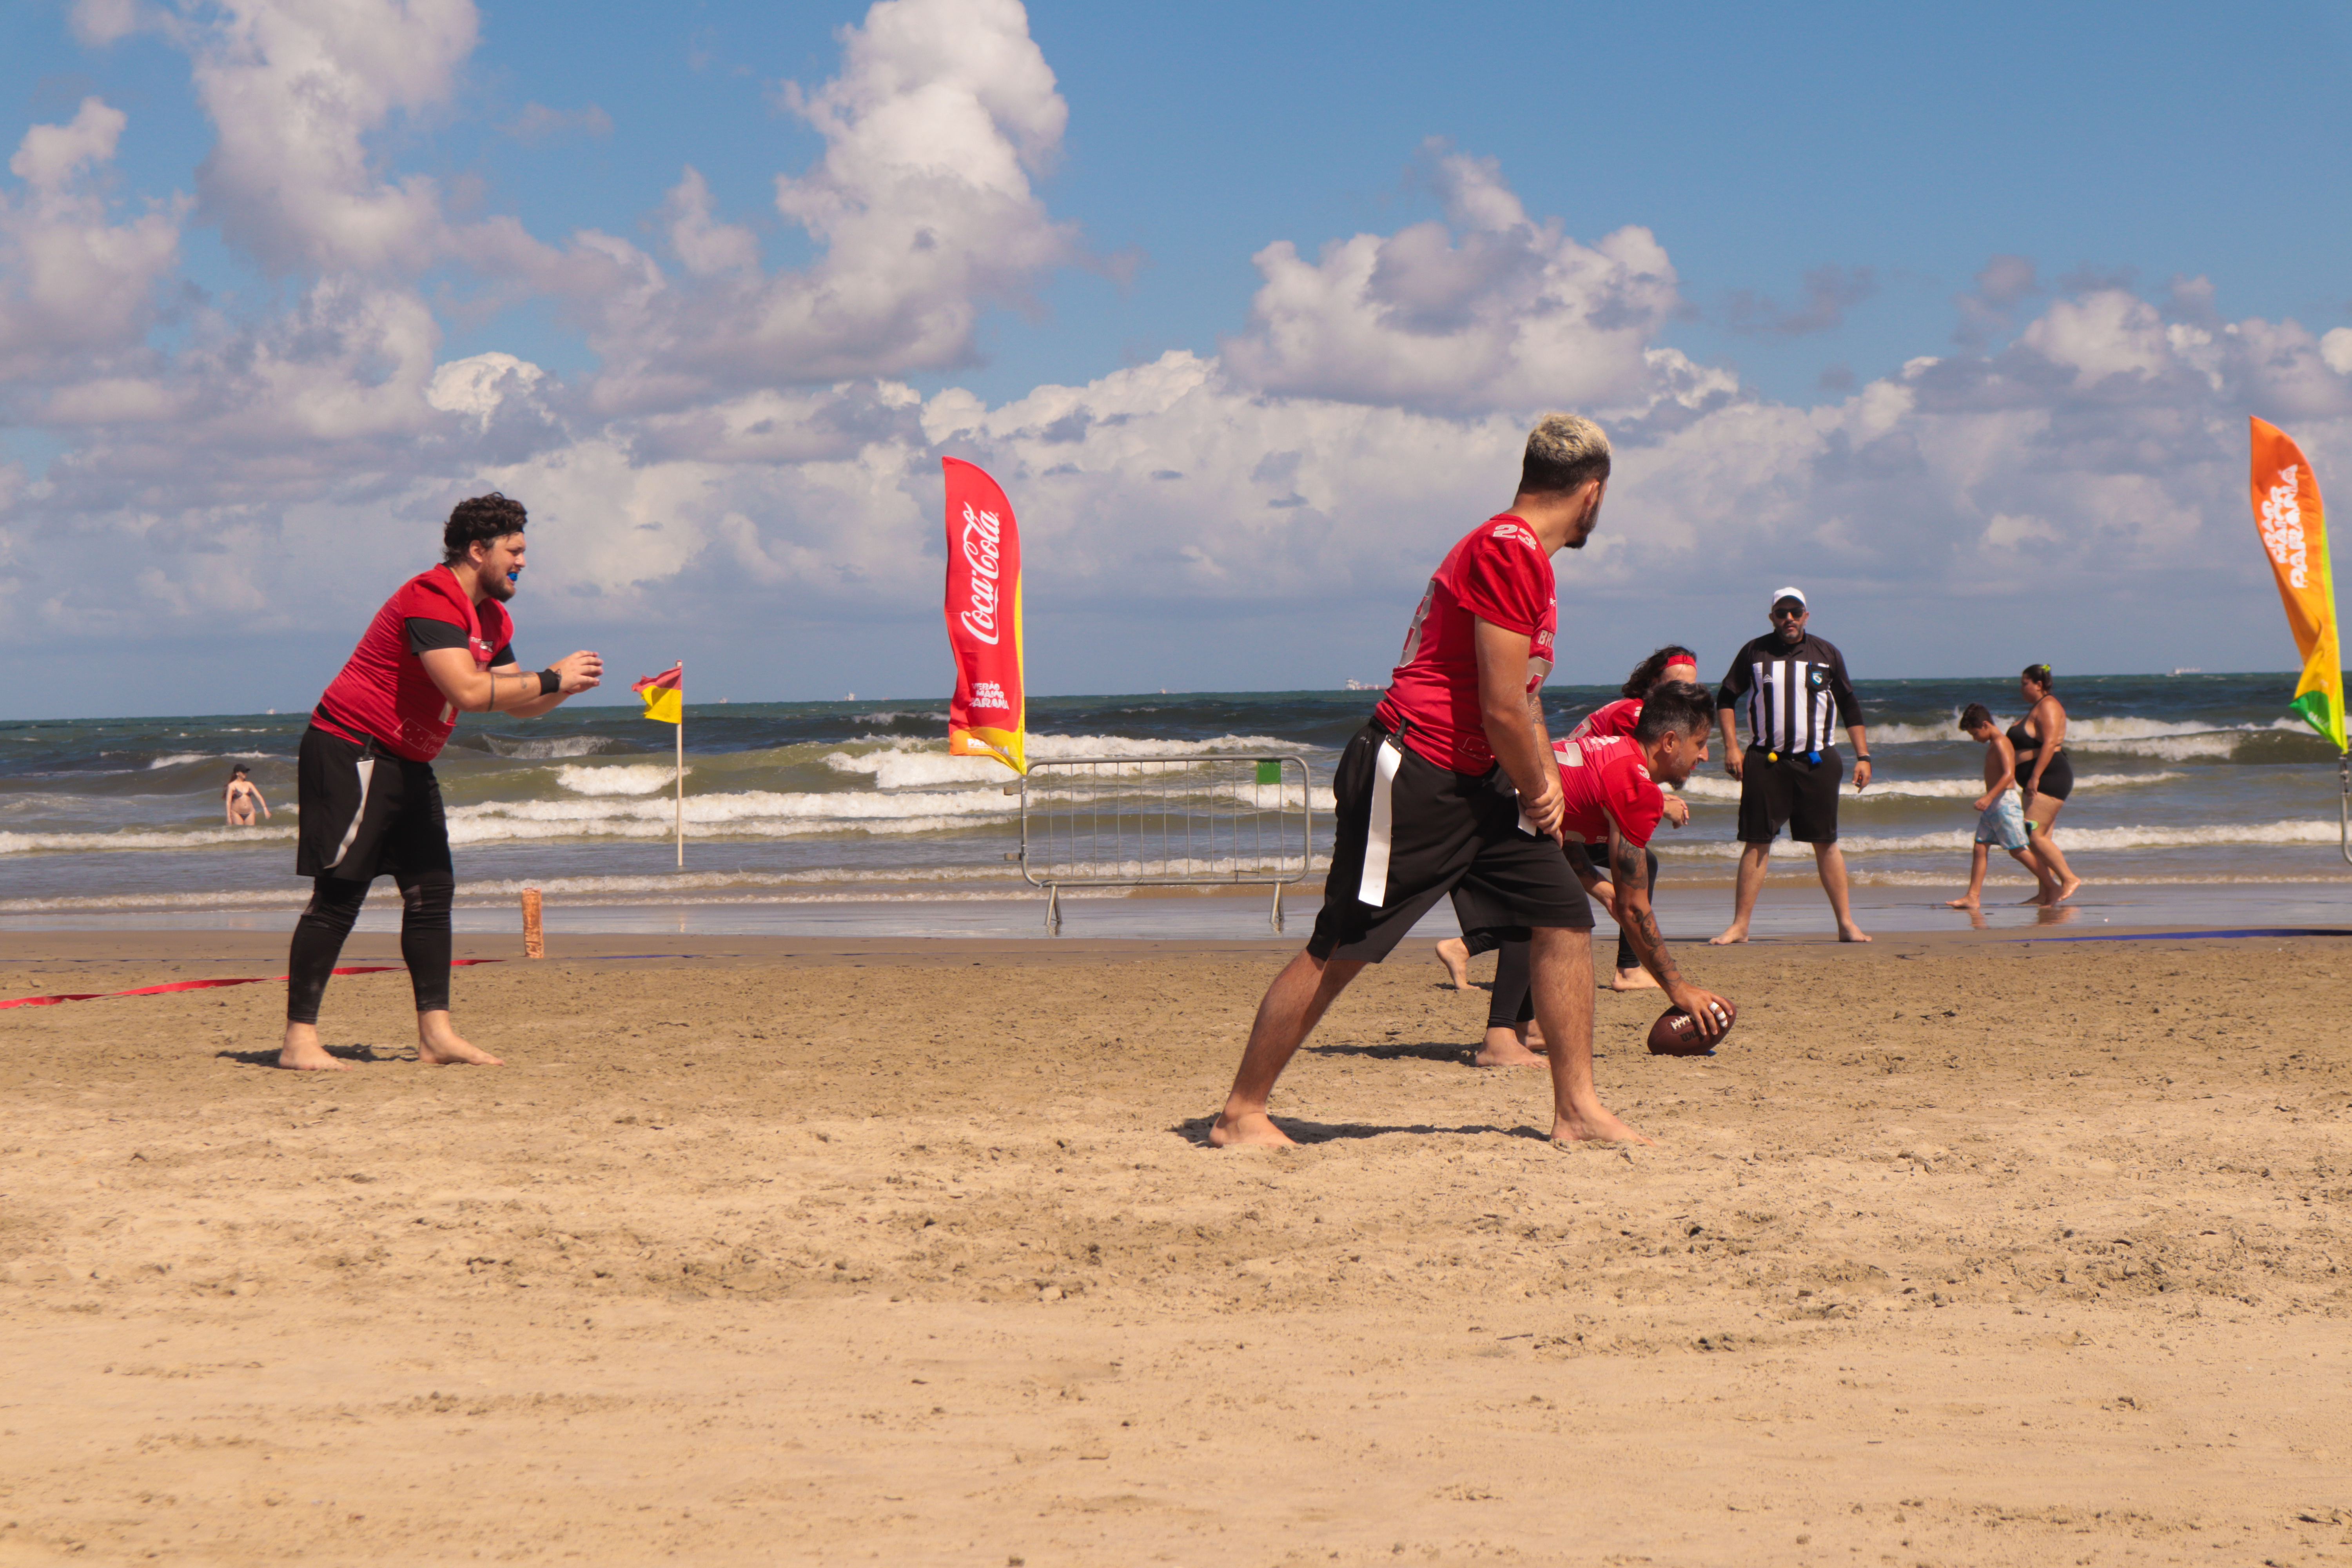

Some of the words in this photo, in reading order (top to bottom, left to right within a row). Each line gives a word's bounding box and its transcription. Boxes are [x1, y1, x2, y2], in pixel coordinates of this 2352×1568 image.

[1493, 524, 1537, 550] 23
[2270, 486, 2288, 563] MAIOR
[2278, 464, 2308, 588] PARANÁ
[961, 501, 1000, 645] Coca-Cola
[1537, 630, 1554, 649] BR
[972, 681, 1000, 691] VERÃO
[976, 690, 1004, 699] MAIOR
